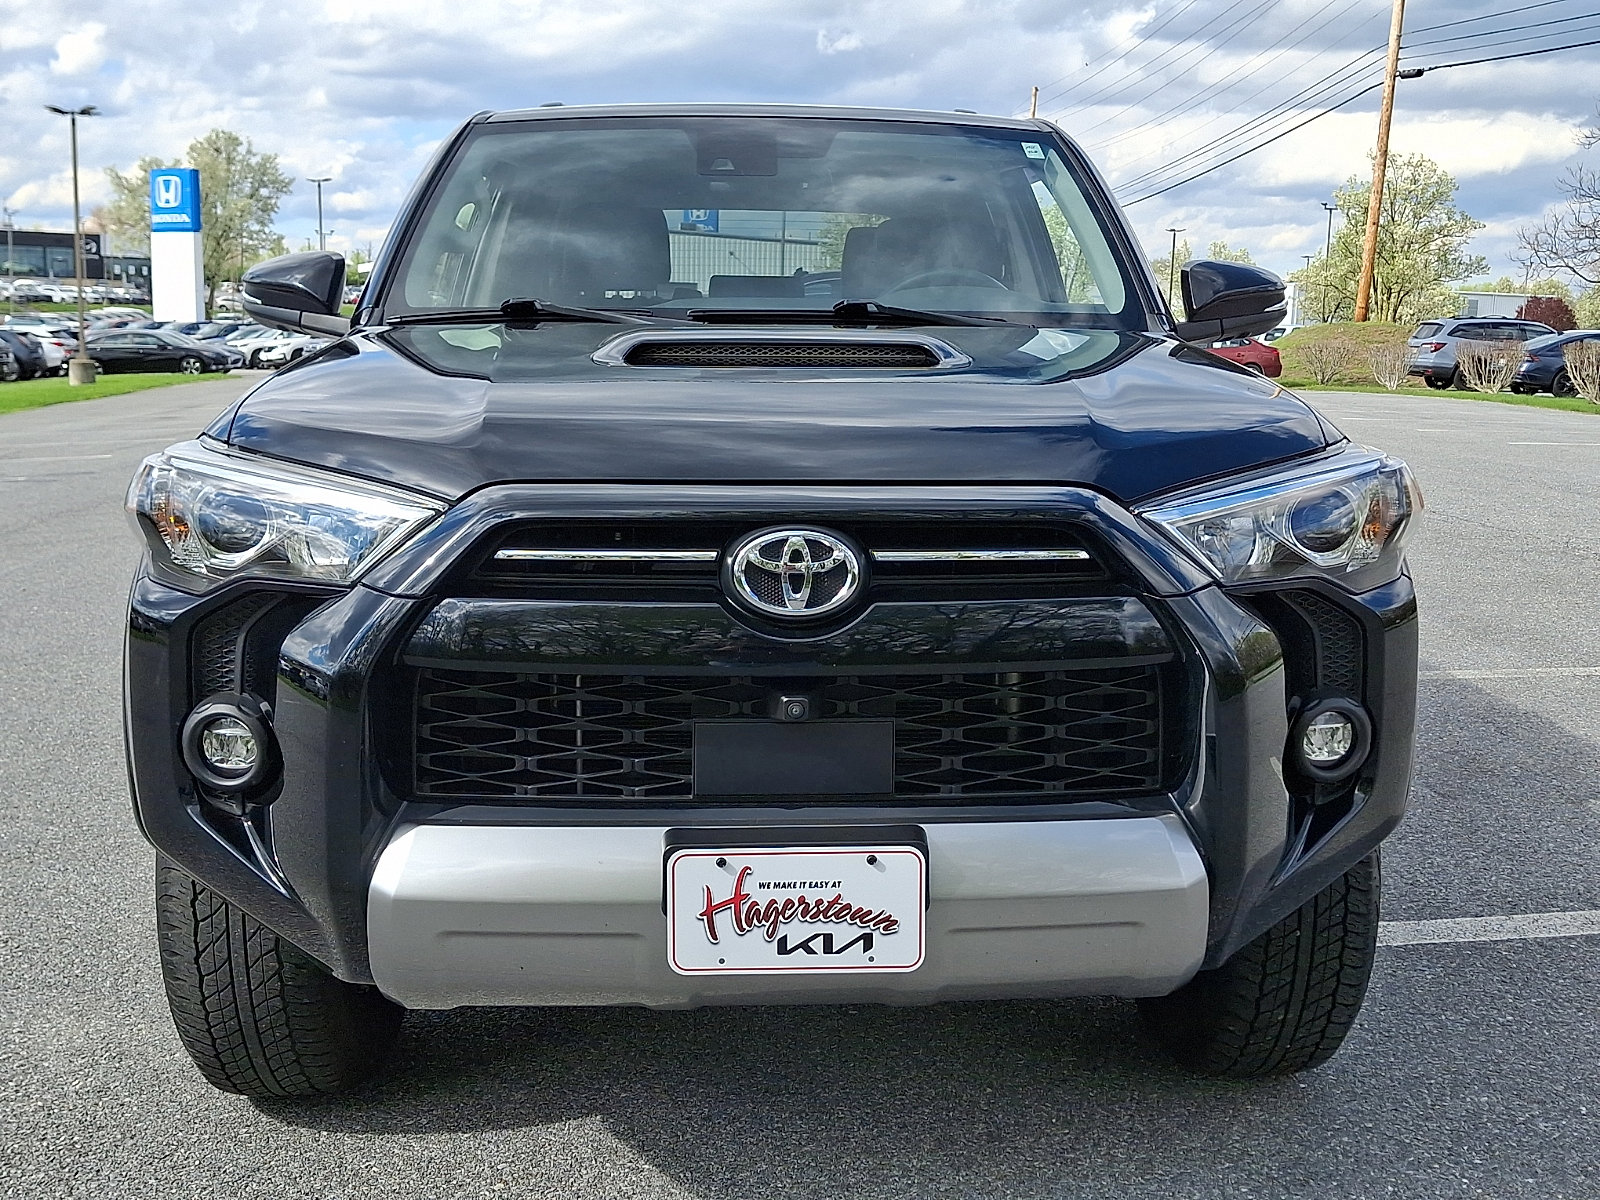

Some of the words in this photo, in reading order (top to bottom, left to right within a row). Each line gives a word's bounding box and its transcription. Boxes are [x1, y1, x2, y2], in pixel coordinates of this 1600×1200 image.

[151, 213, 191, 223] HONDA
[758, 881, 772, 890] WE
[773, 881, 798, 890] MAKE
[799, 881, 808, 889] IT
[808, 881, 830, 889] EASY
[831, 880, 842, 889] AT
[698, 866, 899, 942] Hagerstown
